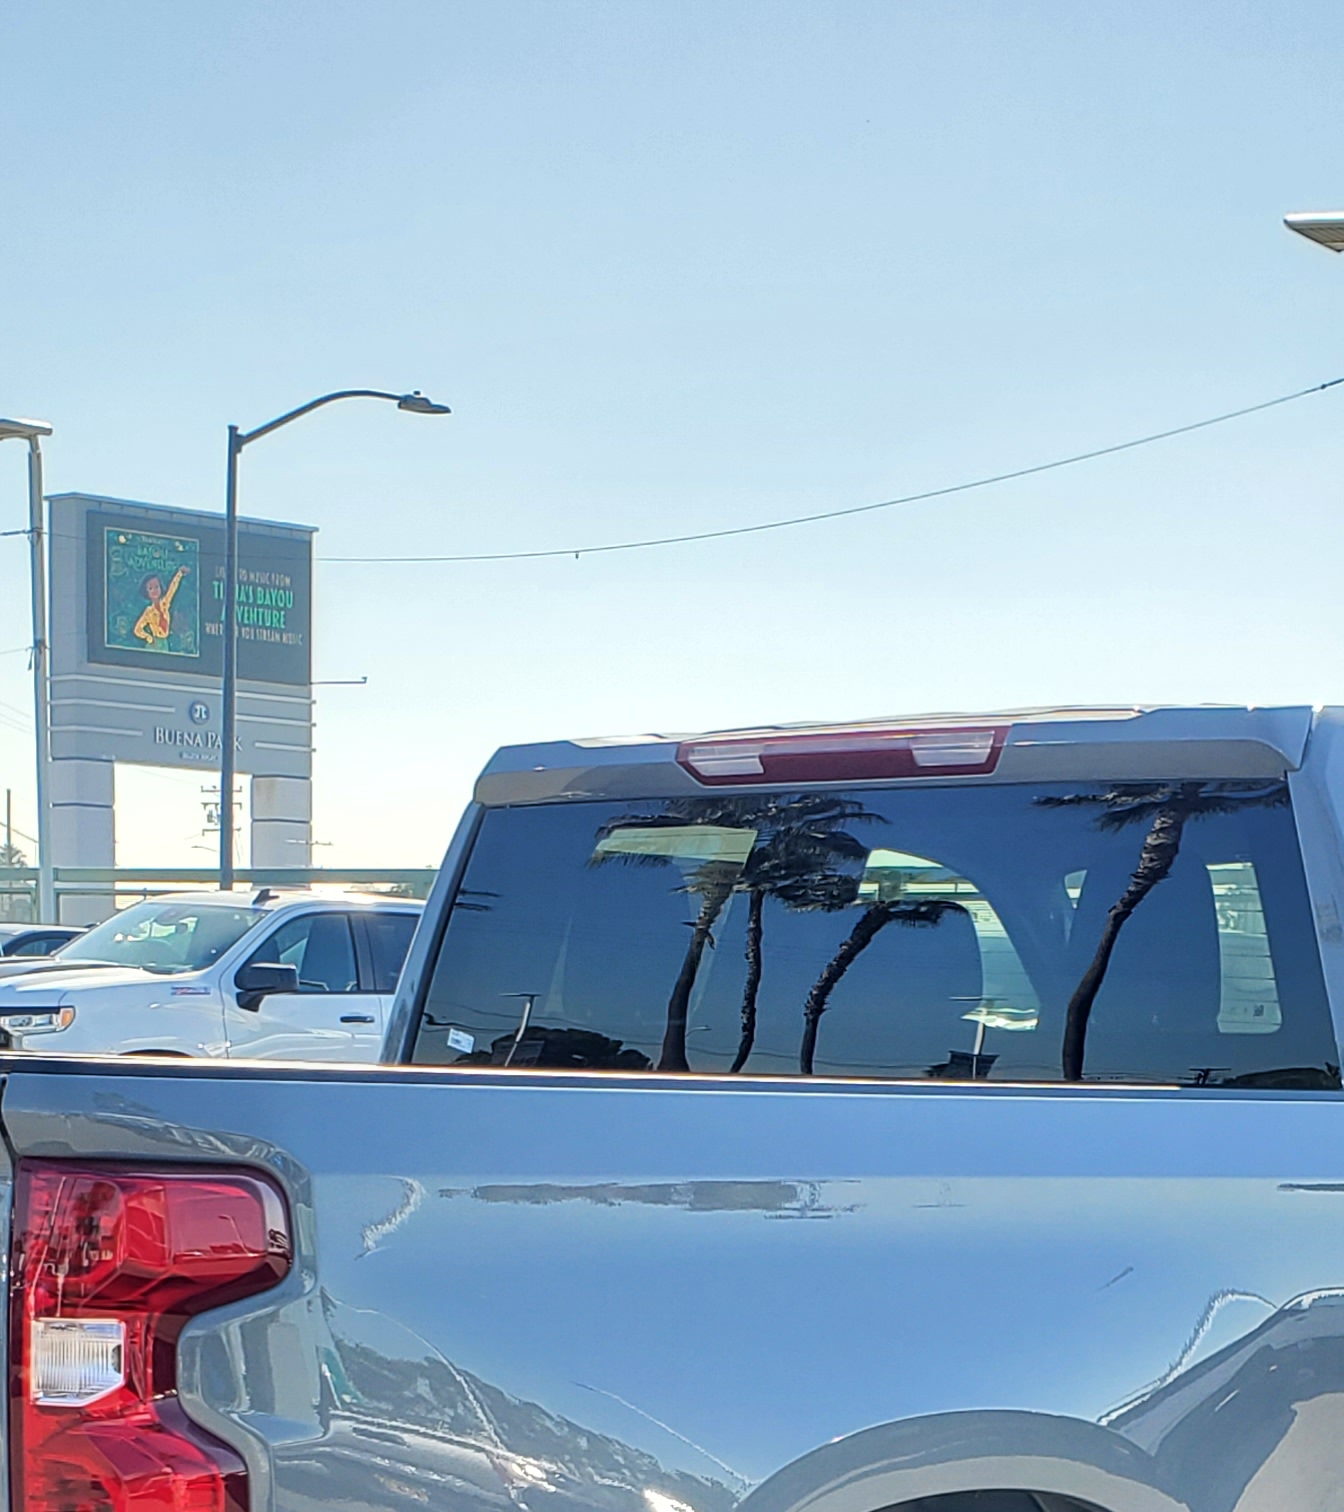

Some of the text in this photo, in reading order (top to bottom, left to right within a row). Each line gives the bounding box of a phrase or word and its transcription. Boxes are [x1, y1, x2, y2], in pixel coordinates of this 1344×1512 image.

[212, 581, 293, 609] TIA'S BAYOU
[221, 604, 285, 628] AVENTURE
[154, 726, 243, 752] BUENA PAK
